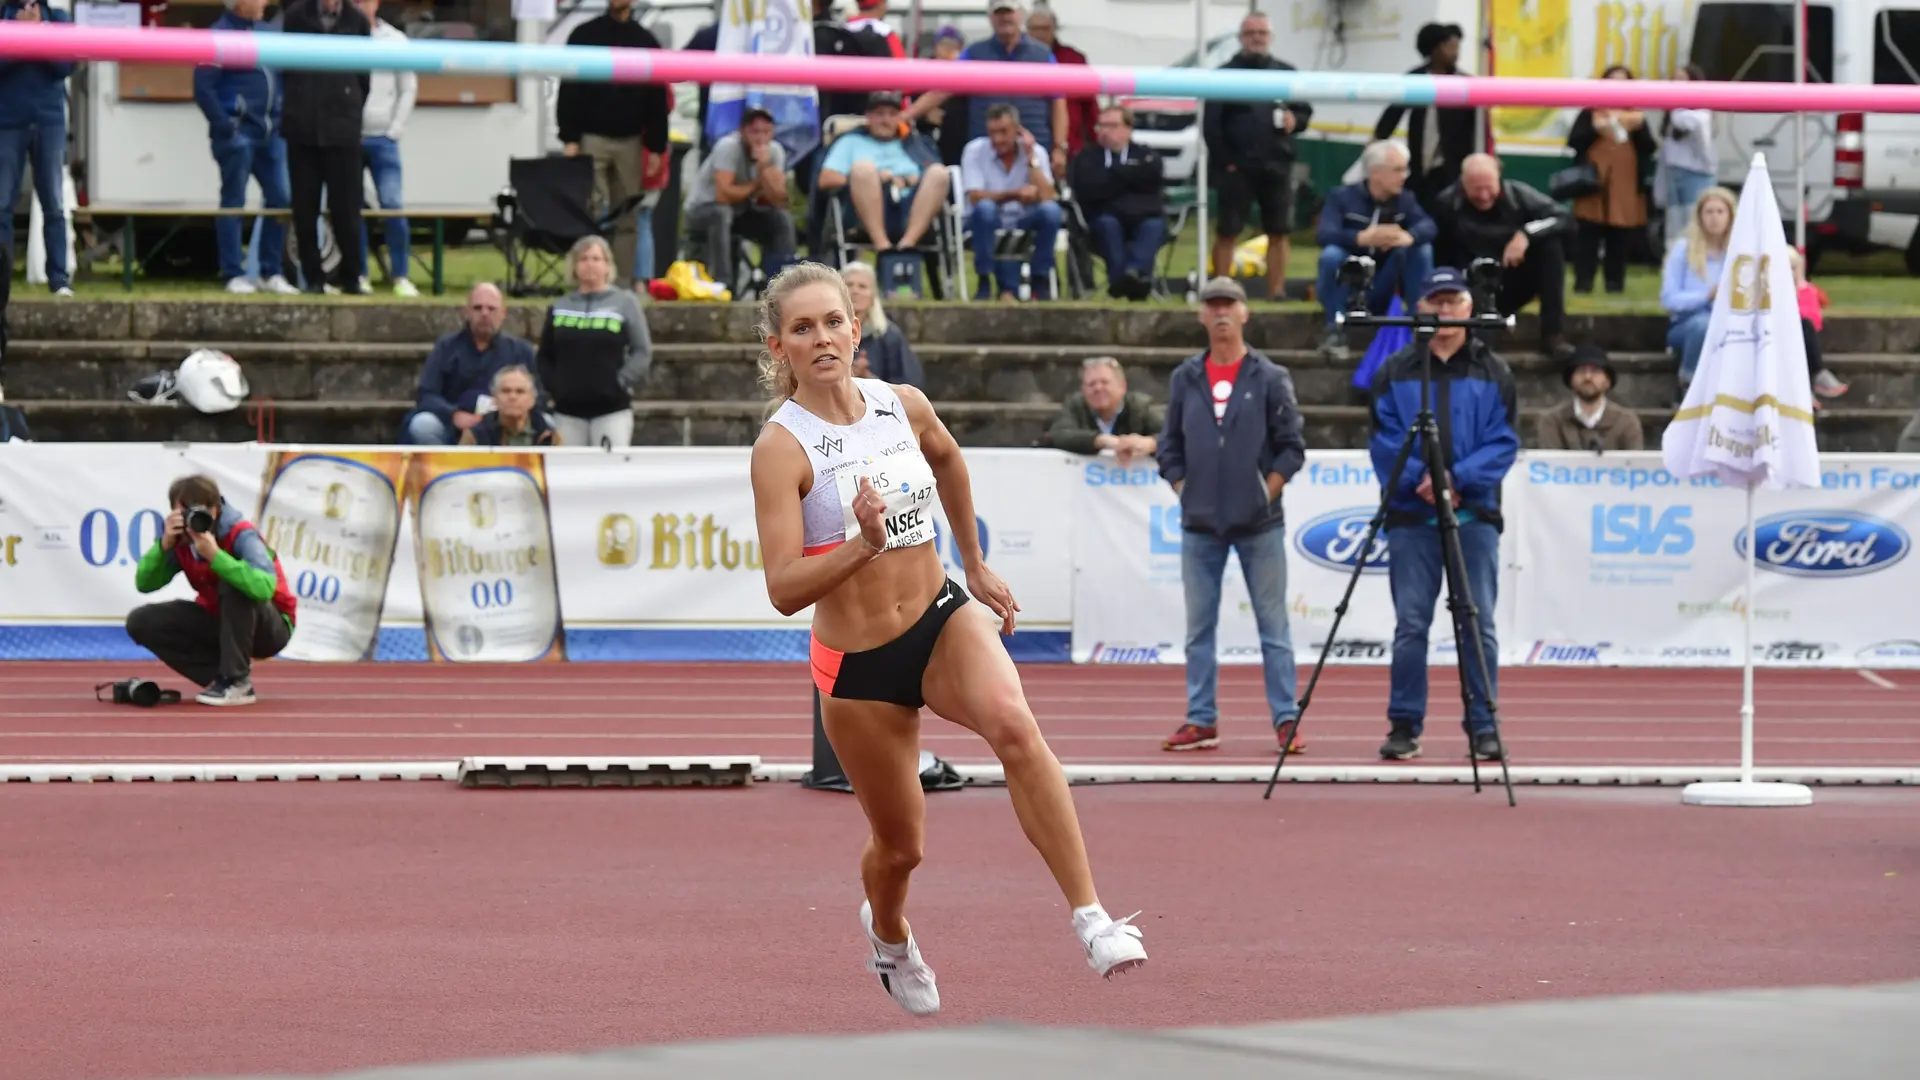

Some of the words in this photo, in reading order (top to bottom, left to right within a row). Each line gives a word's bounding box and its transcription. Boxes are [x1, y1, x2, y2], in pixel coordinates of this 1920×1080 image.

[880, 440, 914, 457] VIACT
[911, 486, 932, 504] 147
[885, 508, 924, 538] NSEL
[1766, 519, 1878, 566] Ford
[296, 569, 341, 605] 0.0
[471, 577, 513, 610] 0.0
